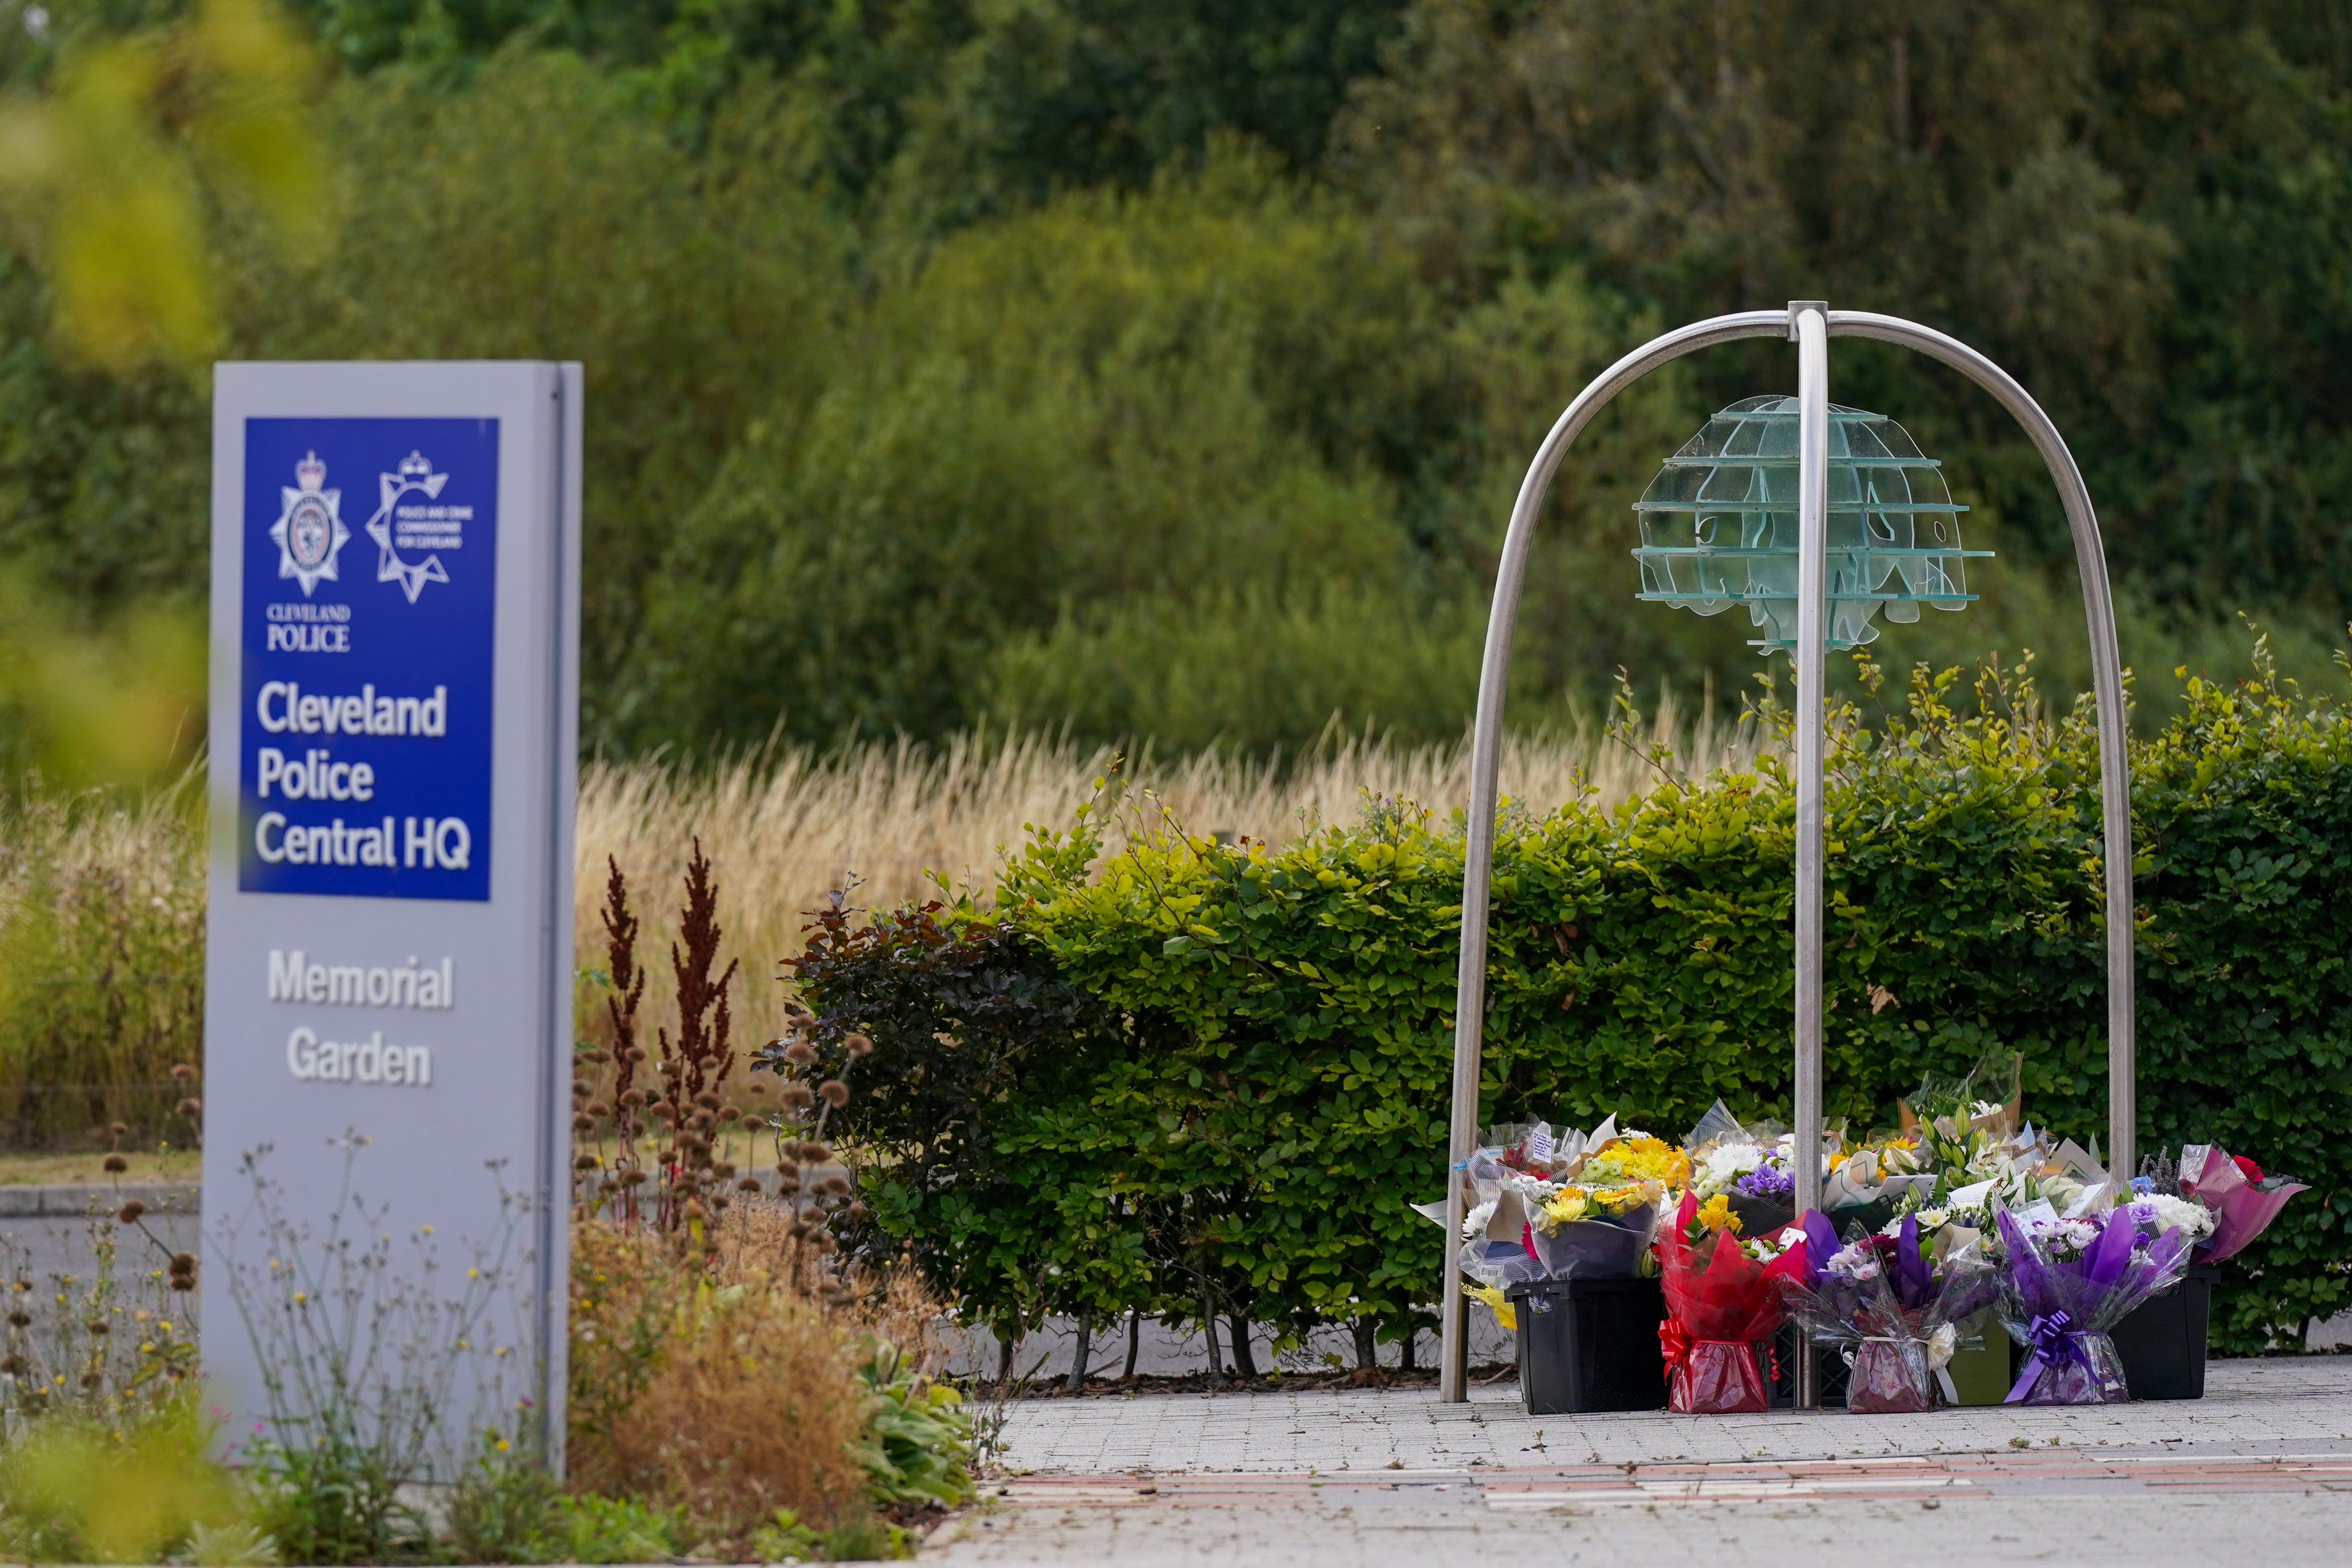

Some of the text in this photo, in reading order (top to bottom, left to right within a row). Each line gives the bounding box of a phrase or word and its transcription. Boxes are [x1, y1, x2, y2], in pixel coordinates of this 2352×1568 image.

[266, 603, 351, 623] CLEVELAND
[267, 624, 351, 652] POLICE
[257, 681, 447, 736] Cleveland
[258, 747, 374, 801] Police
[255, 811, 471, 870] Central HQ
[269, 950, 453, 1008] Memorial
[287, 1026, 431, 1085] Garden
